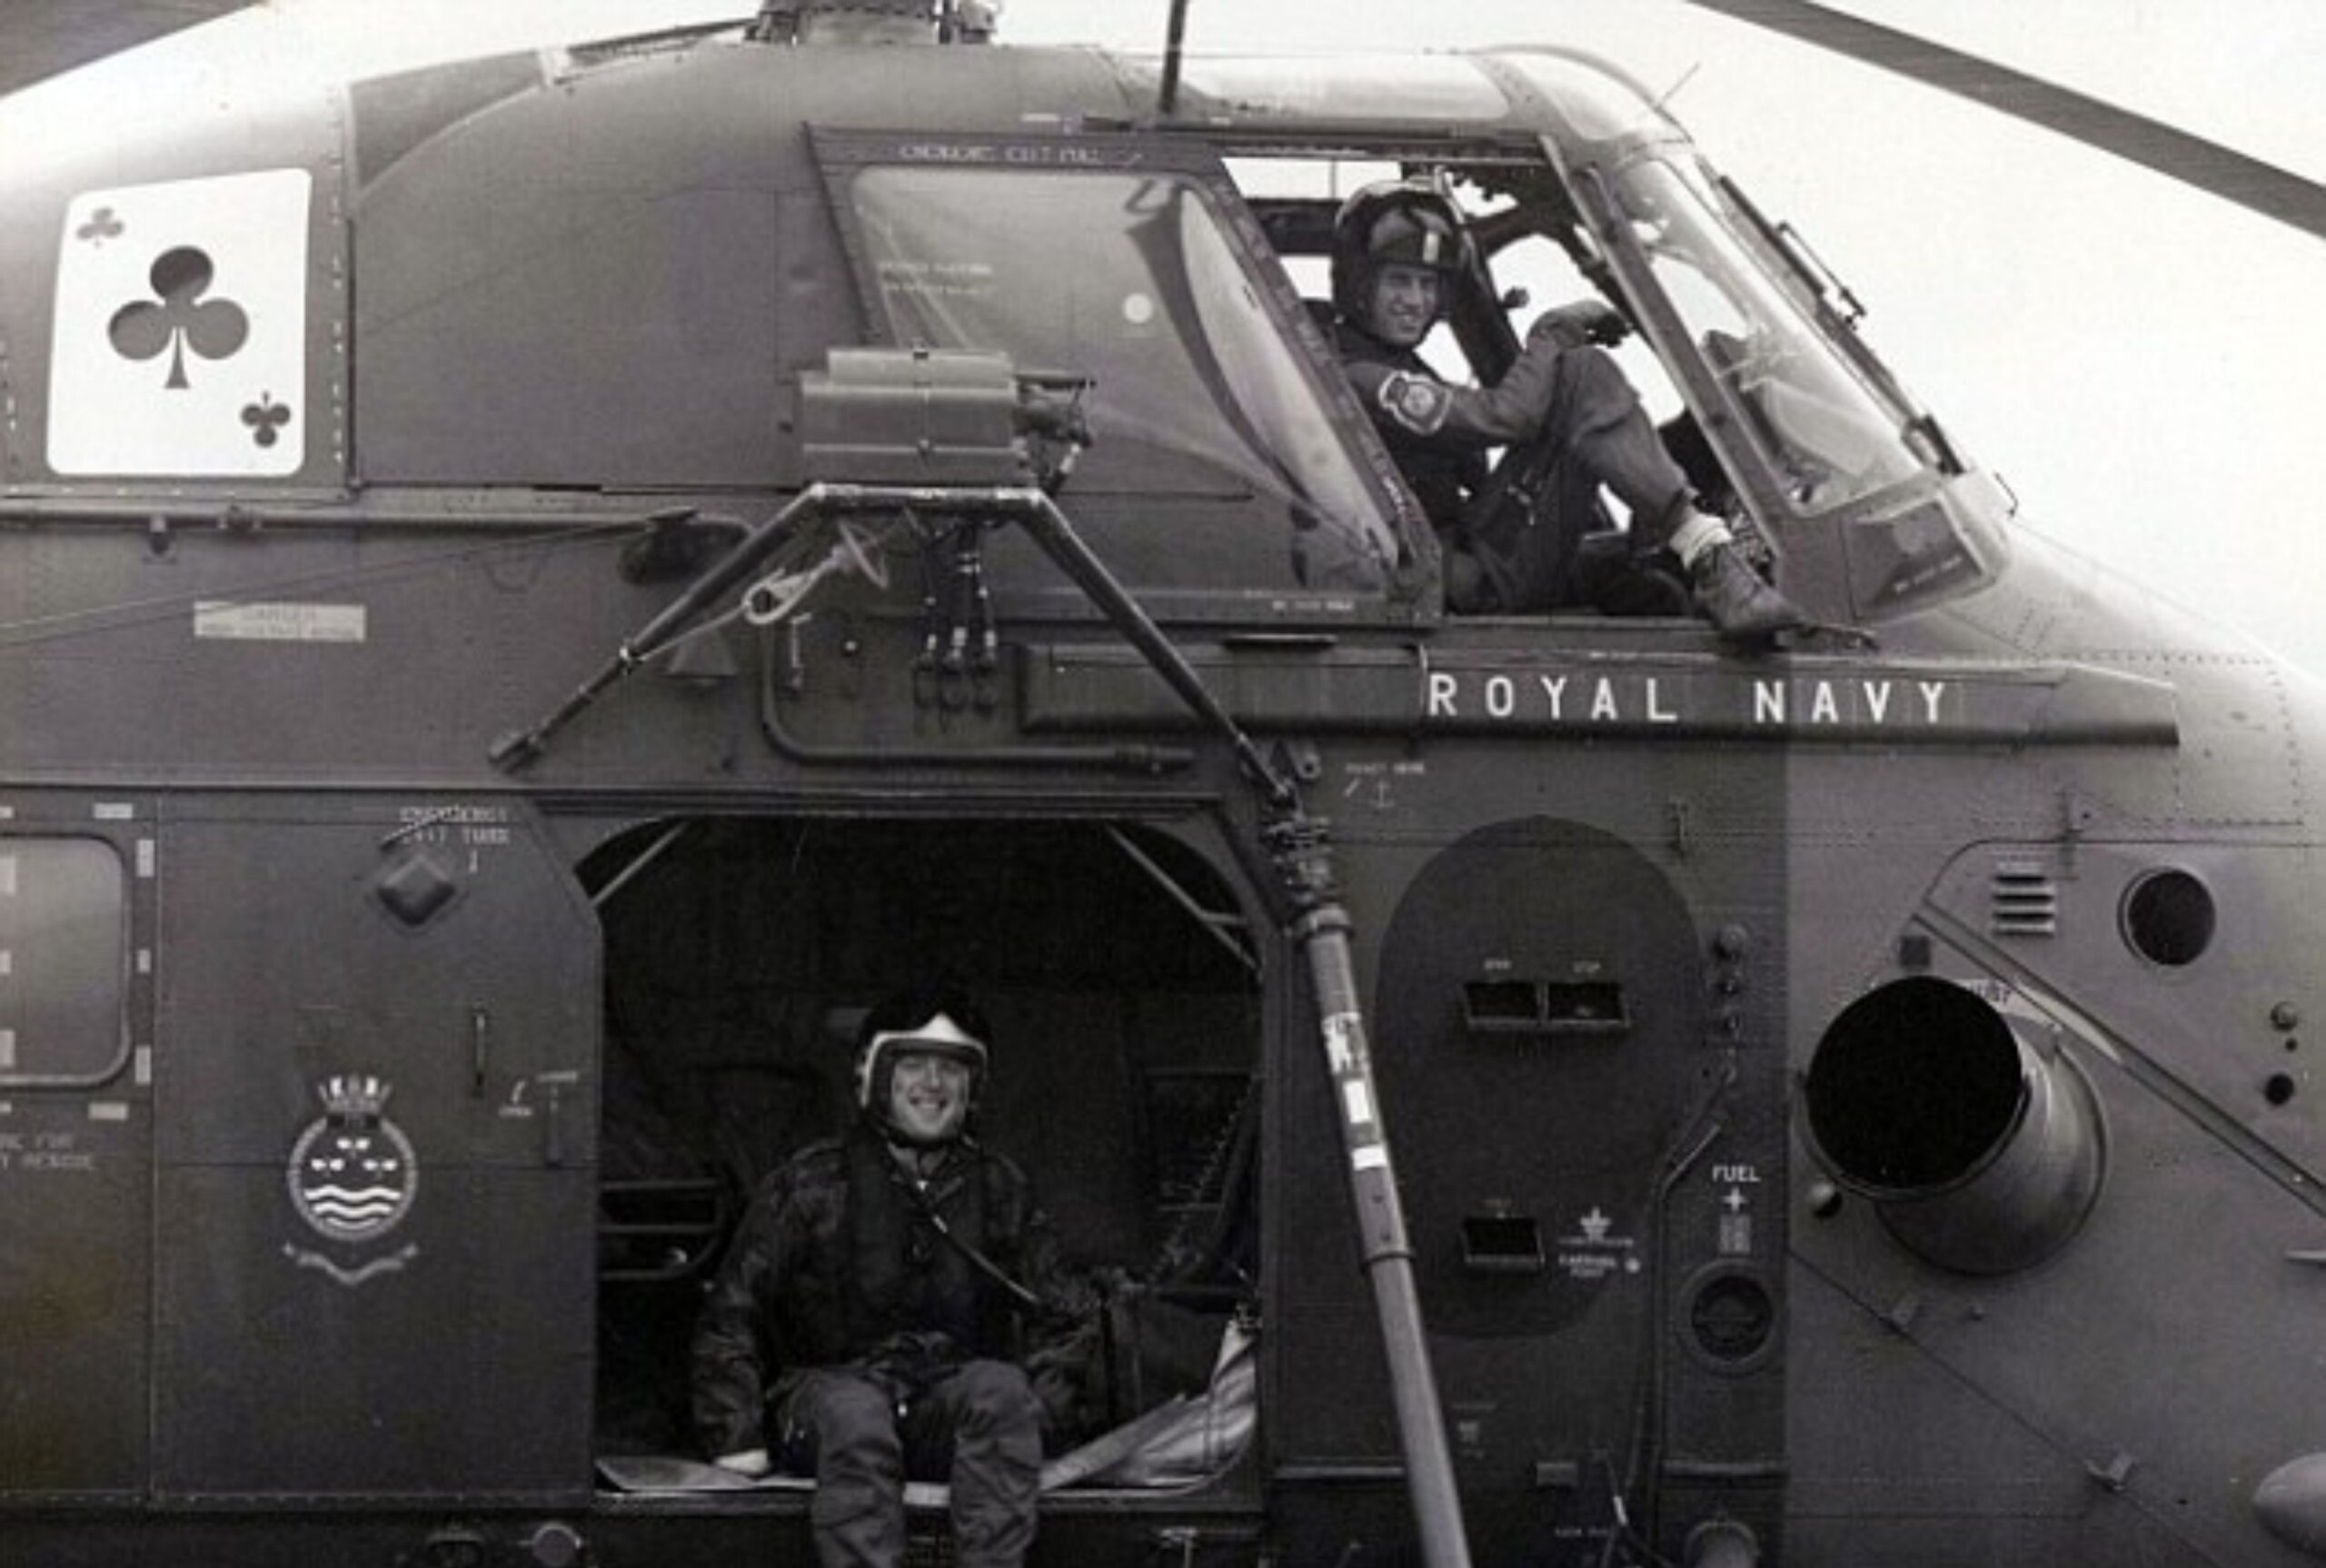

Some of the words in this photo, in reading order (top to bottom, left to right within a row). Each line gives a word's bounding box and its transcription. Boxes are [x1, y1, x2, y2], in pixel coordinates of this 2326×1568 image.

[1426, 672, 1679, 722] ROYAL
[1754, 680, 1947, 724] NAVY
[1712, 1164, 1762, 1183] FUEL
